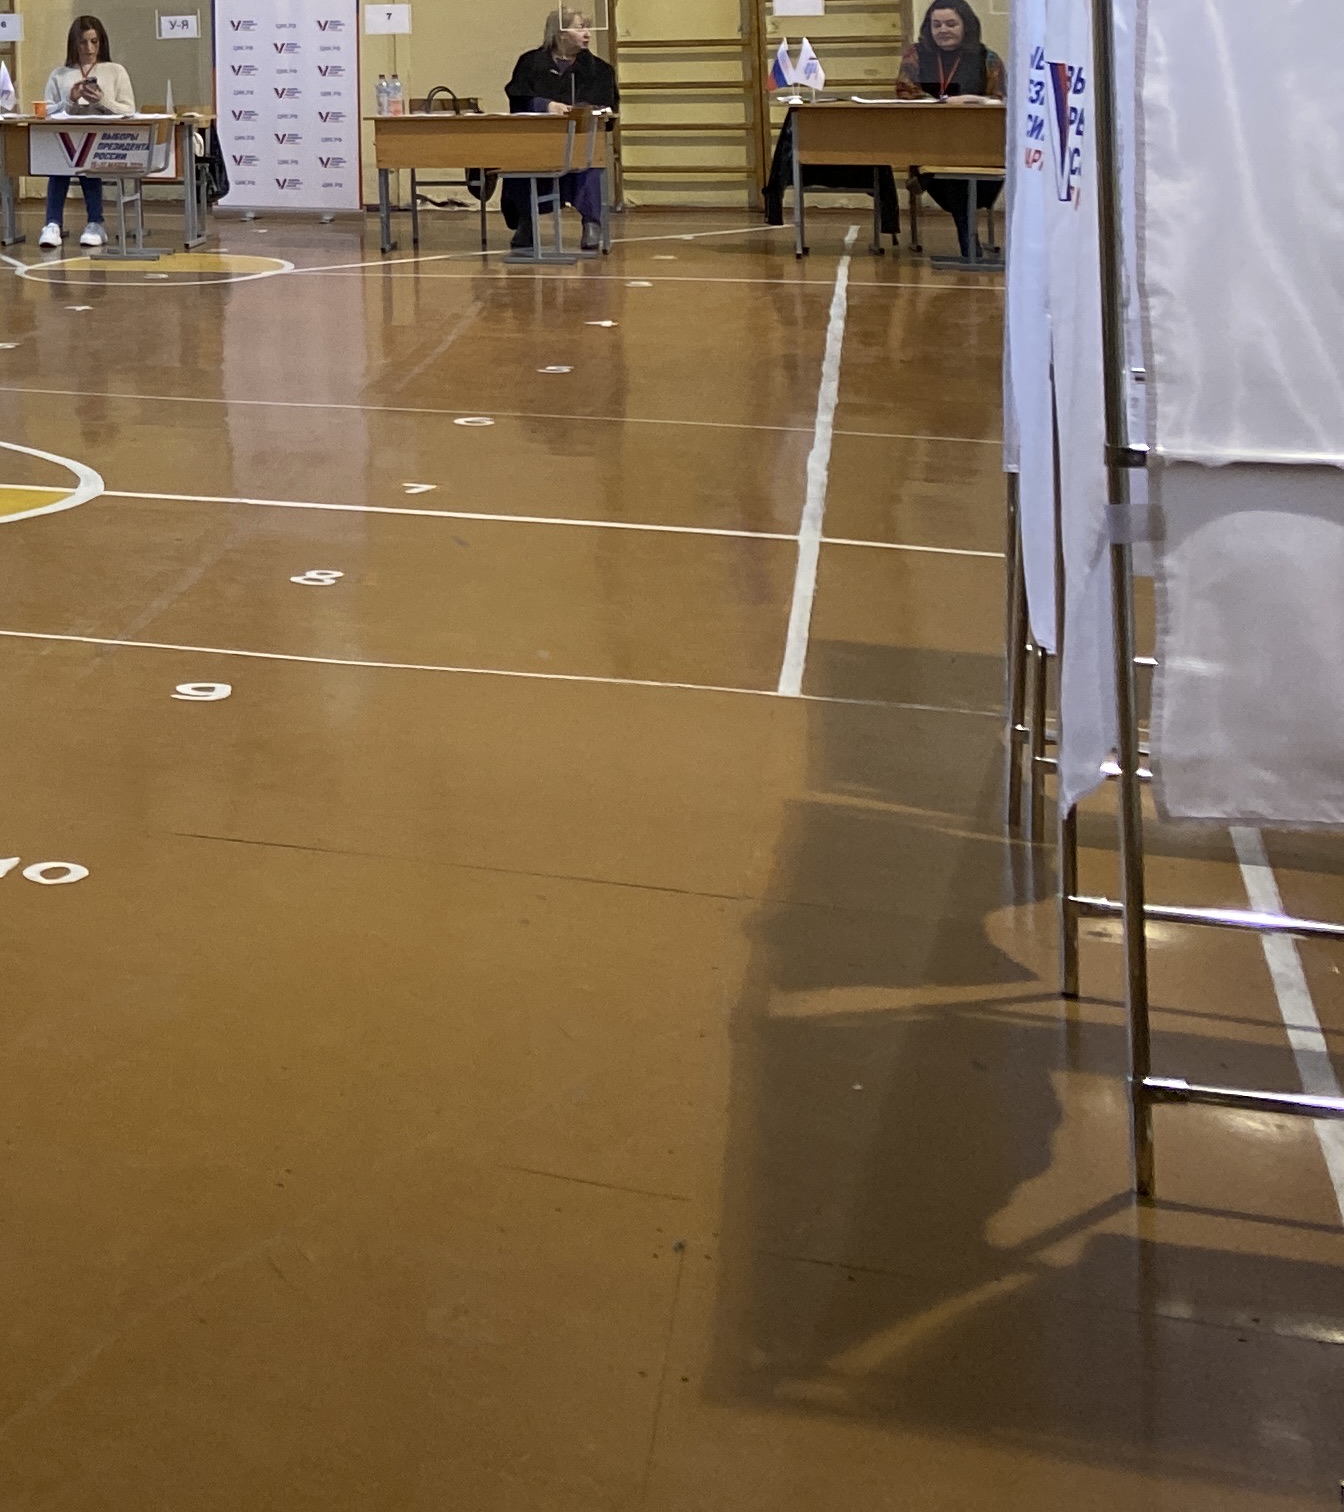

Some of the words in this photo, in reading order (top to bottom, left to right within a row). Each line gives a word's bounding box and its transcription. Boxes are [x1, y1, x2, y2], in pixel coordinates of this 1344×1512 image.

[386, 12, 392, 21] 7
[169, 20, 189, 30] У-Я
[101, 133, 139, 141] ВЫБОРЫ
[92, 152, 127, 160] РОССИИ
[401, 482, 437, 494] 7
[289, 569, 344, 586] 8
[170, 682, 232, 701] 9
